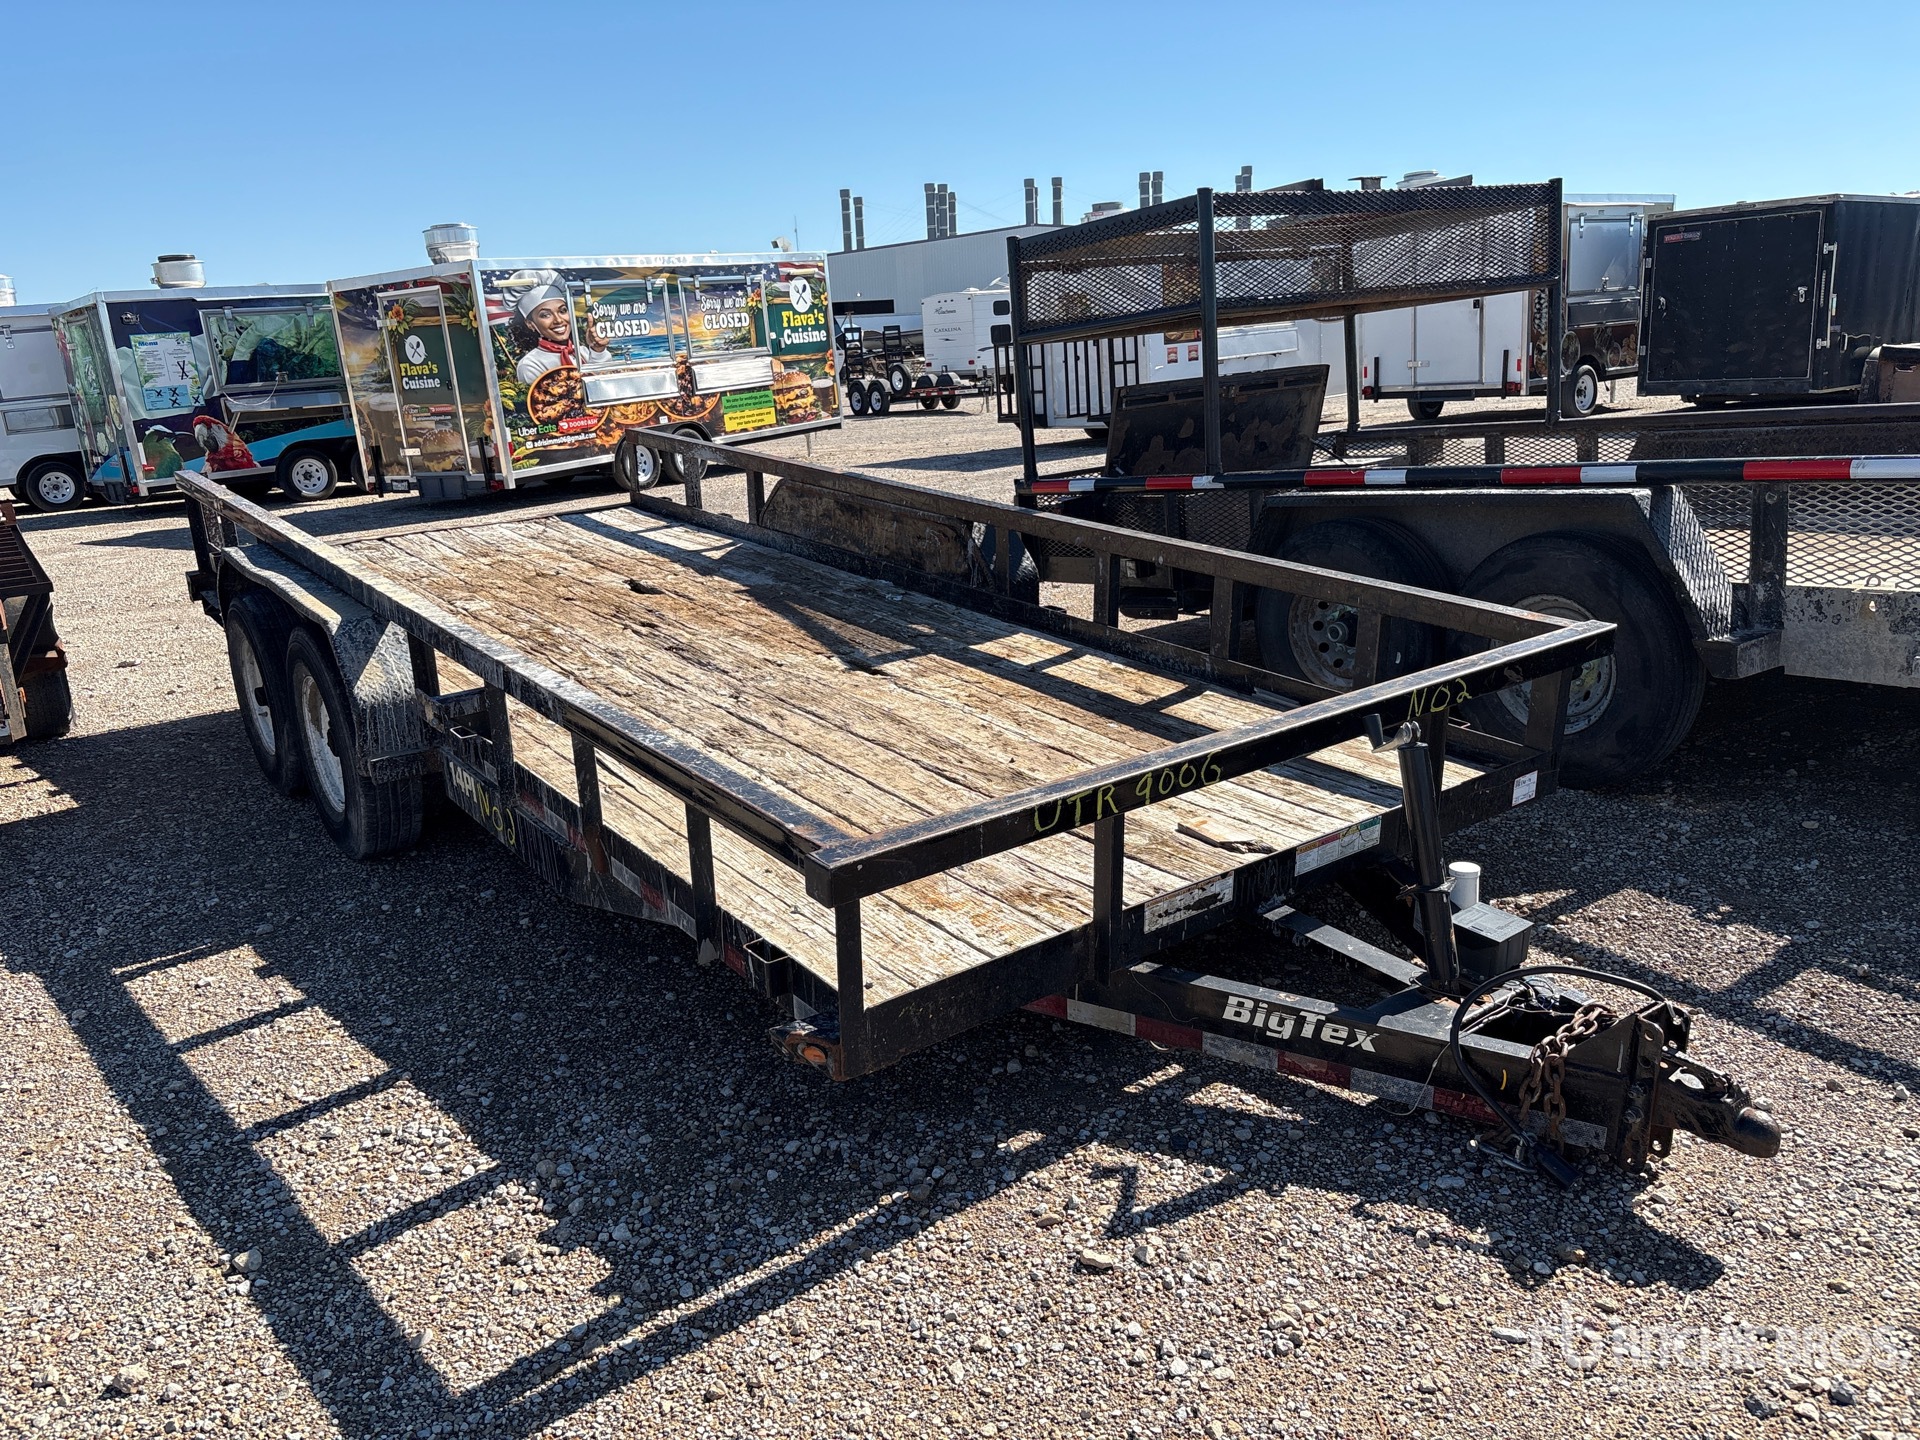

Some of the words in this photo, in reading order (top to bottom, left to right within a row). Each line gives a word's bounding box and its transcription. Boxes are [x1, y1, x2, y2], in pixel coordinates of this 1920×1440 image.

[592, 303, 618, 319] Sorry,
[620, 305, 631, 315] we
[633, 302, 647, 315] are
[701, 296, 721, 312] Sorry,
[724, 297, 733, 308] we
[734, 296, 746, 308] are
[704, 312, 749, 330] CLOSED
[781, 309, 825, 327] Flava's
[595, 318, 650, 338] CLOSED
[783, 327, 827, 345] Cuisine
[400, 361, 438, 376] Flava's
[402, 376, 440, 389] Cuisine
[518, 427, 537, 437] Uber
[538, 424, 557, 434] Eats
[1034, 783, 1119, 832] UTR
[1222, 995, 1380, 1053] BigTex
